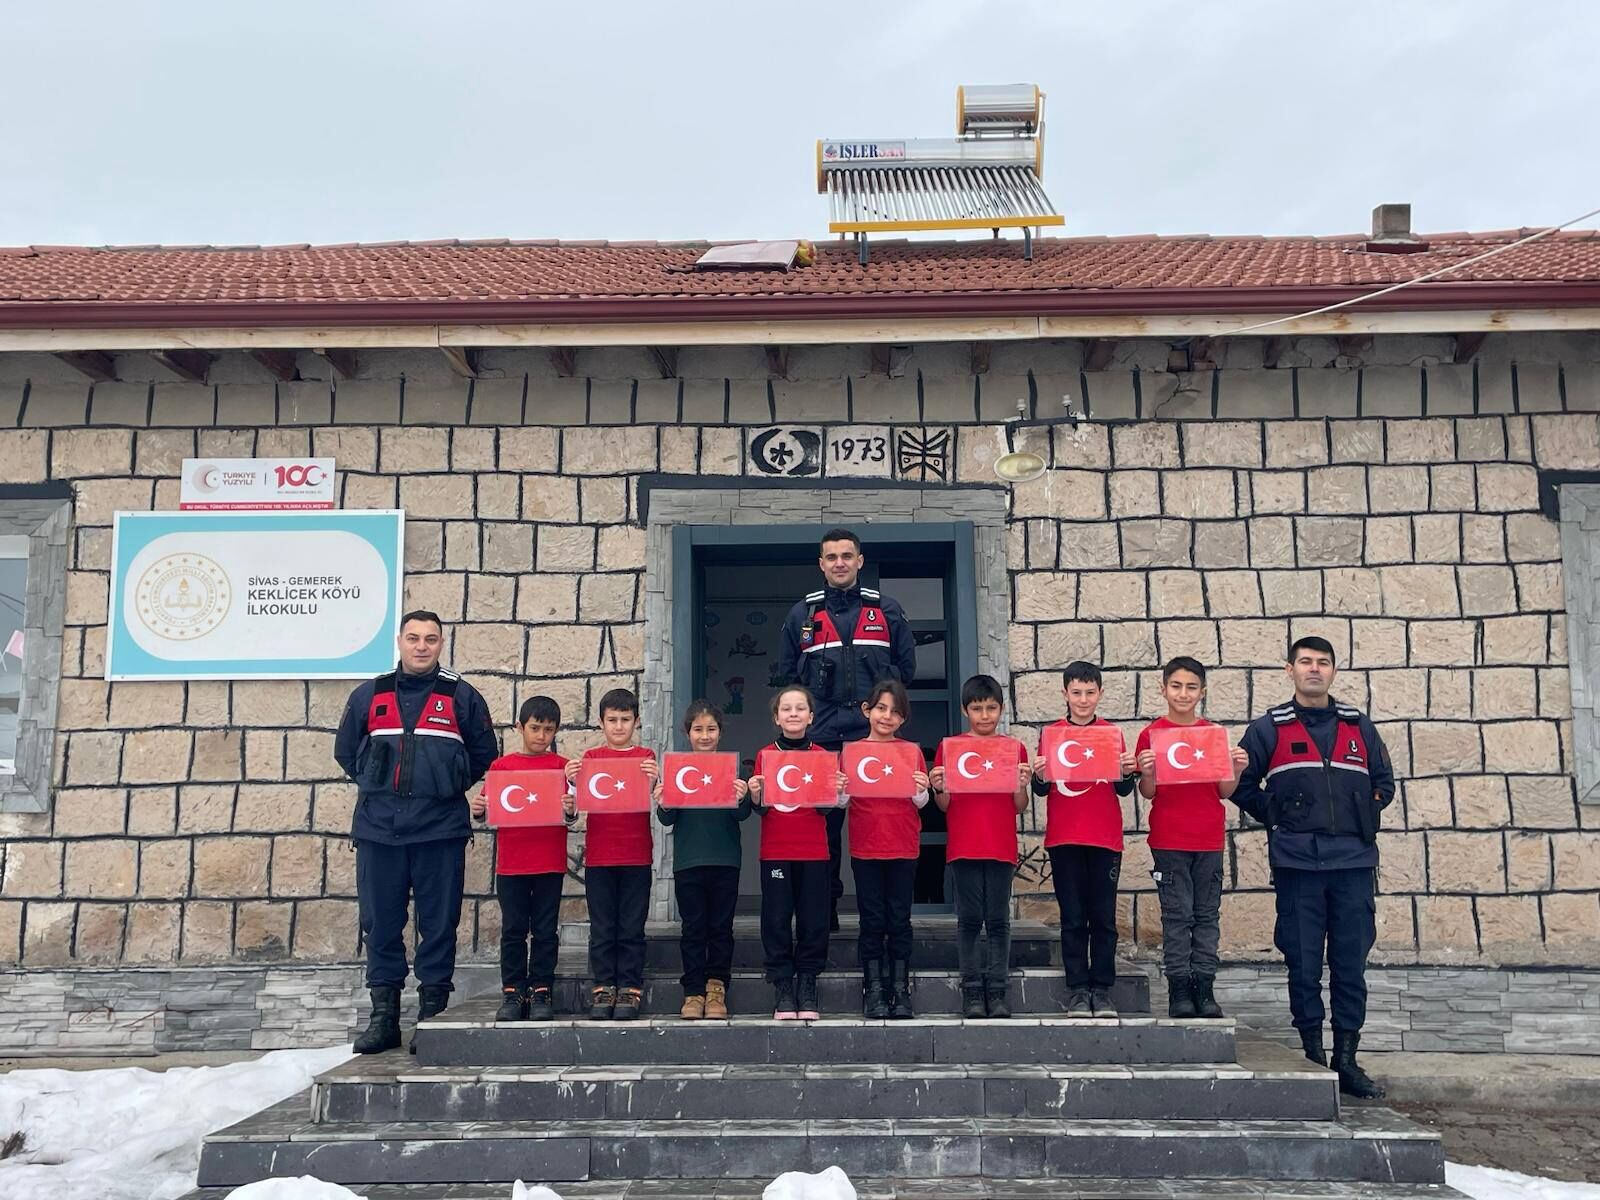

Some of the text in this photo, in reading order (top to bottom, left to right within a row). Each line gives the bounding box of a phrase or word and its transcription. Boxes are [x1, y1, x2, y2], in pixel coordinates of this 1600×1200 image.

[831, 436, 886, 463] 1973
[248, 575, 279, 586] SİVAS
[288, 576, 343, 586] GEMEREK
[248, 586, 361, 600] KEKLİCEK KÖYÜ
[247, 602, 318, 616] İLKOKULU
